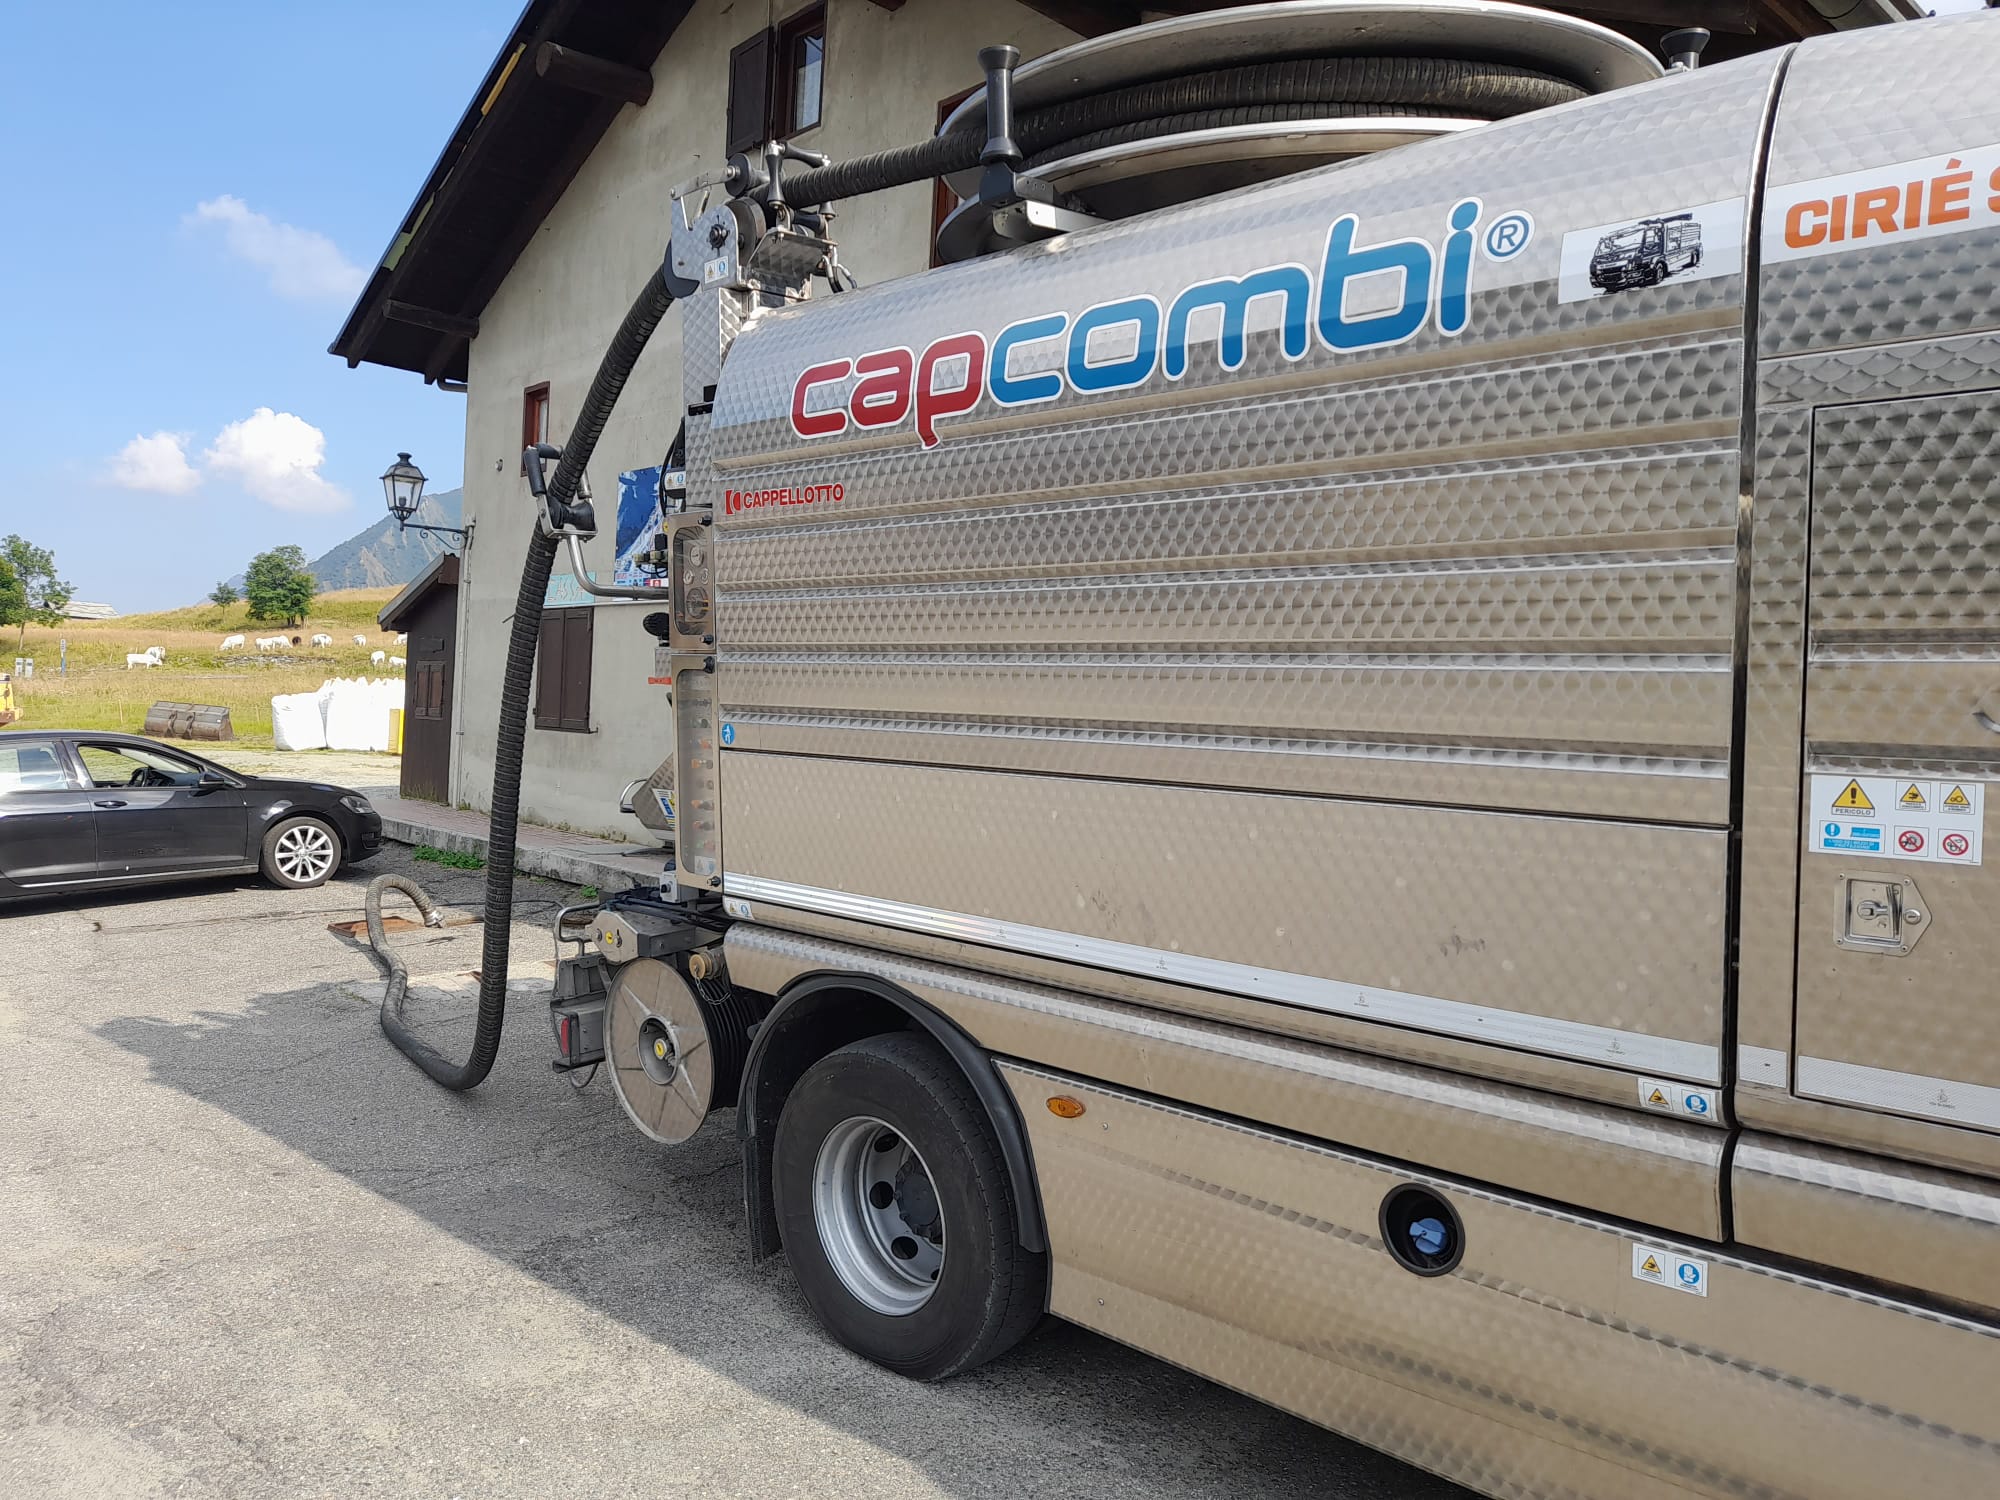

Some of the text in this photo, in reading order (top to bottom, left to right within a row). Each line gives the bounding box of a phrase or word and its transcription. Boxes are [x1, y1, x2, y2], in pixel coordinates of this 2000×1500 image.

[1784, 158, 1973, 249] CIRIÉ
[743, 483, 844, 509] CAPPELLOTTO
[1835, 808, 1871, 816] PERICOLO
